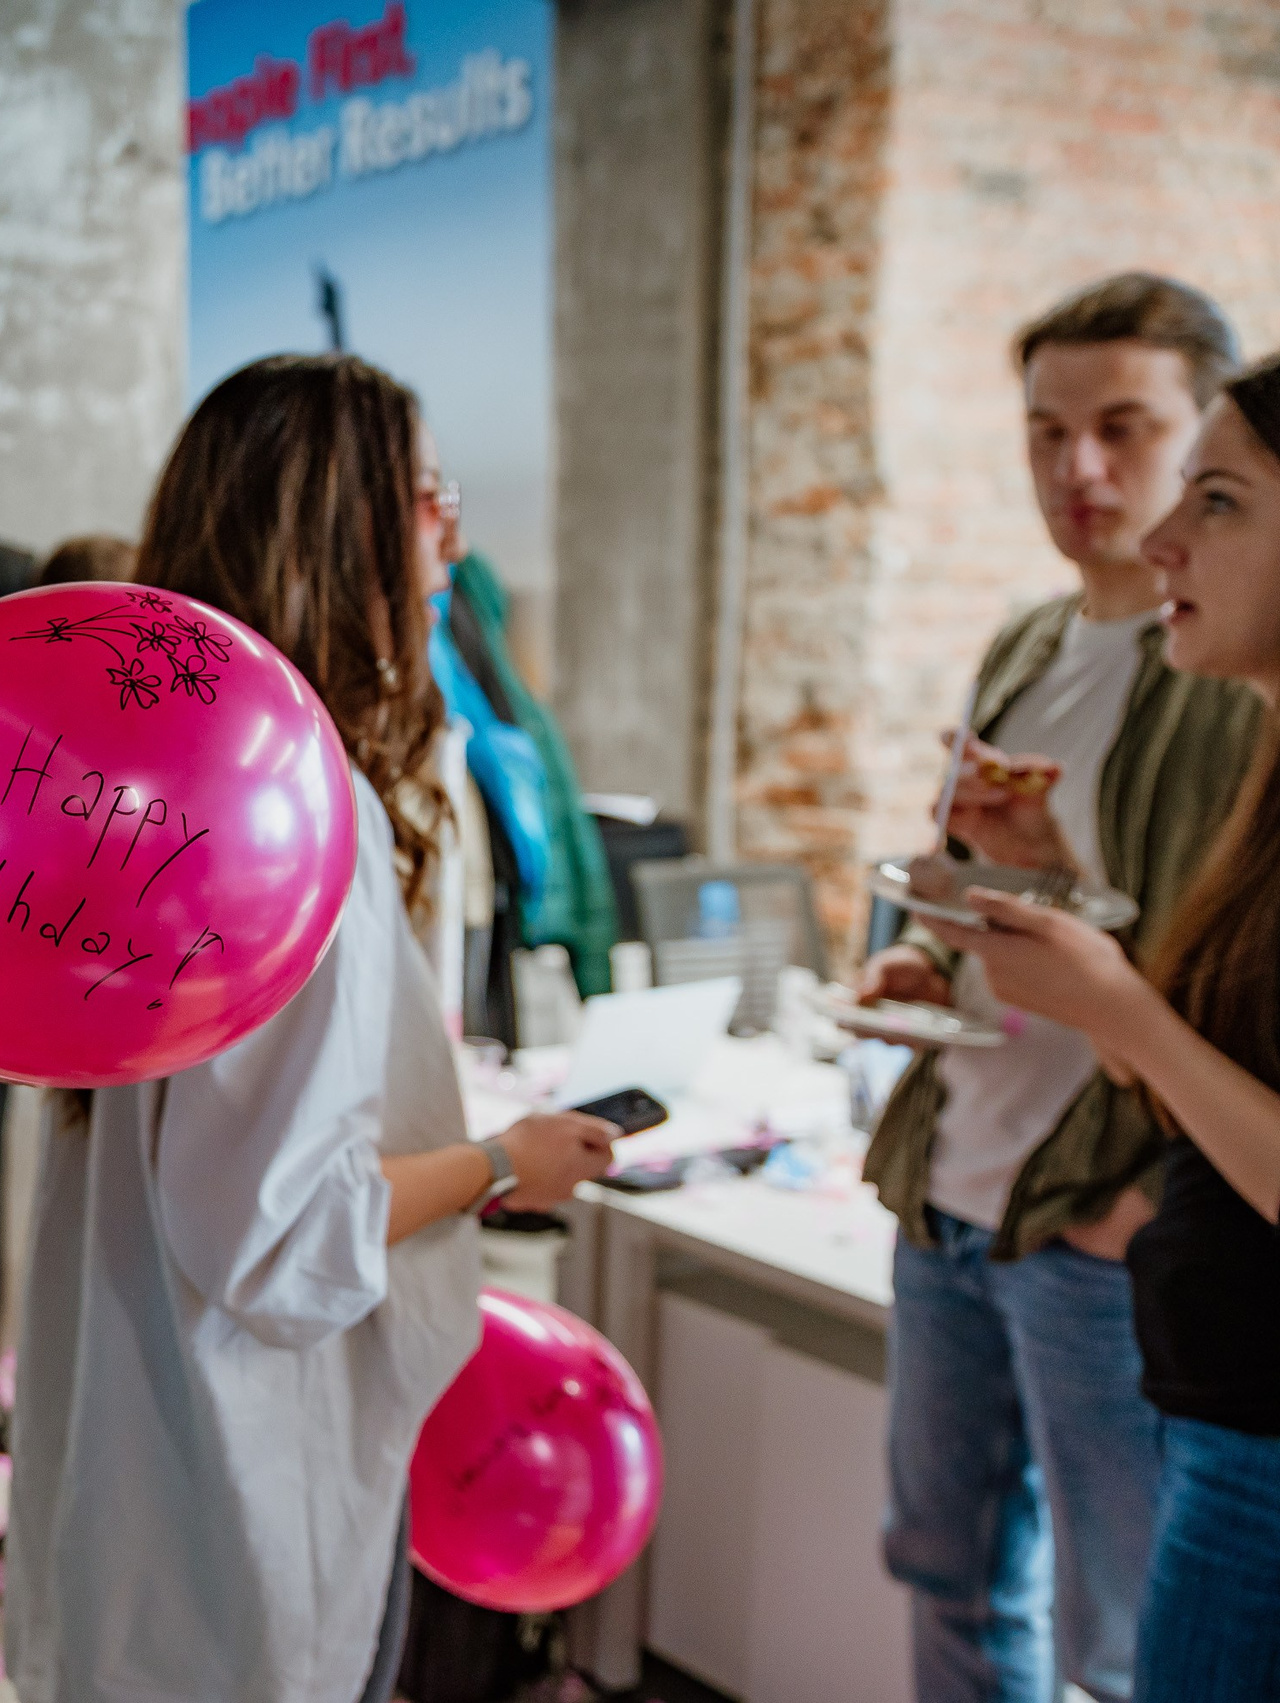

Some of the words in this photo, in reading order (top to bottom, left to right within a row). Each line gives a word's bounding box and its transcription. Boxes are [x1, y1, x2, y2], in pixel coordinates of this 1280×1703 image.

[201, 121, 333, 223] Better
[338, 46, 532, 177] Results
[0, 724, 210, 908] Happy
